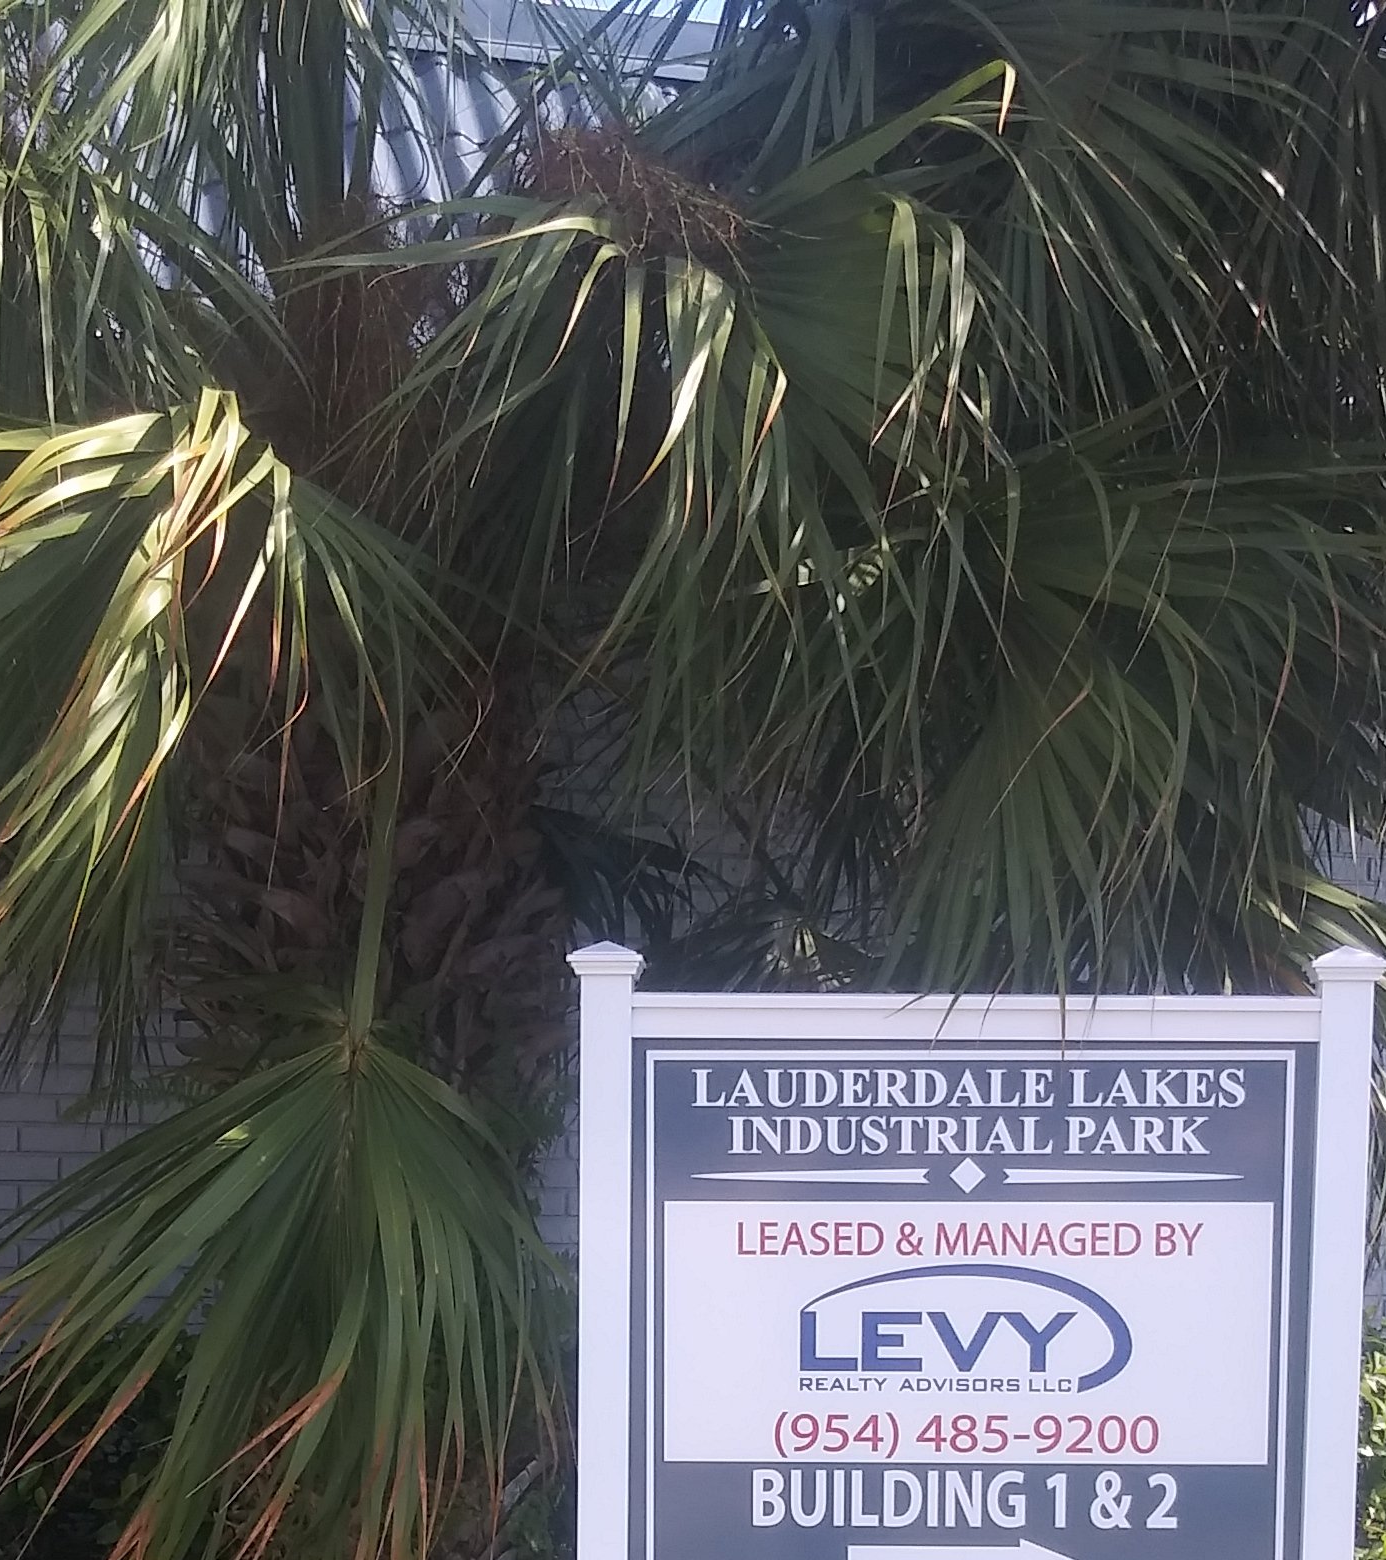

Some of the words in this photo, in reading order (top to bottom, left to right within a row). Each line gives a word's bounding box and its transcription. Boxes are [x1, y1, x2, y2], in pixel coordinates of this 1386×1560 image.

[692, 1068, 1055, 1108] LAUDERDALE
[1067, 1068, 1246, 1108] LAKES
[727, 1115, 1054, 1155] INDUSTRIAL
[1063, 1115, 1211, 1155] PARK
[736, 1221, 885, 1256] LEASED
[895, 1221, 924, 1257] &
[934, 1221, 1142, 1257] MANAGED
[1154, 1221, 1205, 1257] BY
[799, 1310, 1079, 1373] LEVY
[798, 1377, 888, 1392] REALTY
[899, 1377, 1020, 1393] ADVISORS
[1028, 1377, 1073, 1394] LLC
[774, 1410, 900, 1460] (954)
[915, 1413, 1160, 1455] 485-9200
[751, 1468, 1027, 1530] BUILDING
[1045, 1470, 1069, 1530] 1
[1089, 1469, 1133, 1531] &
[1146, 1471, 1179, 1530] 2
